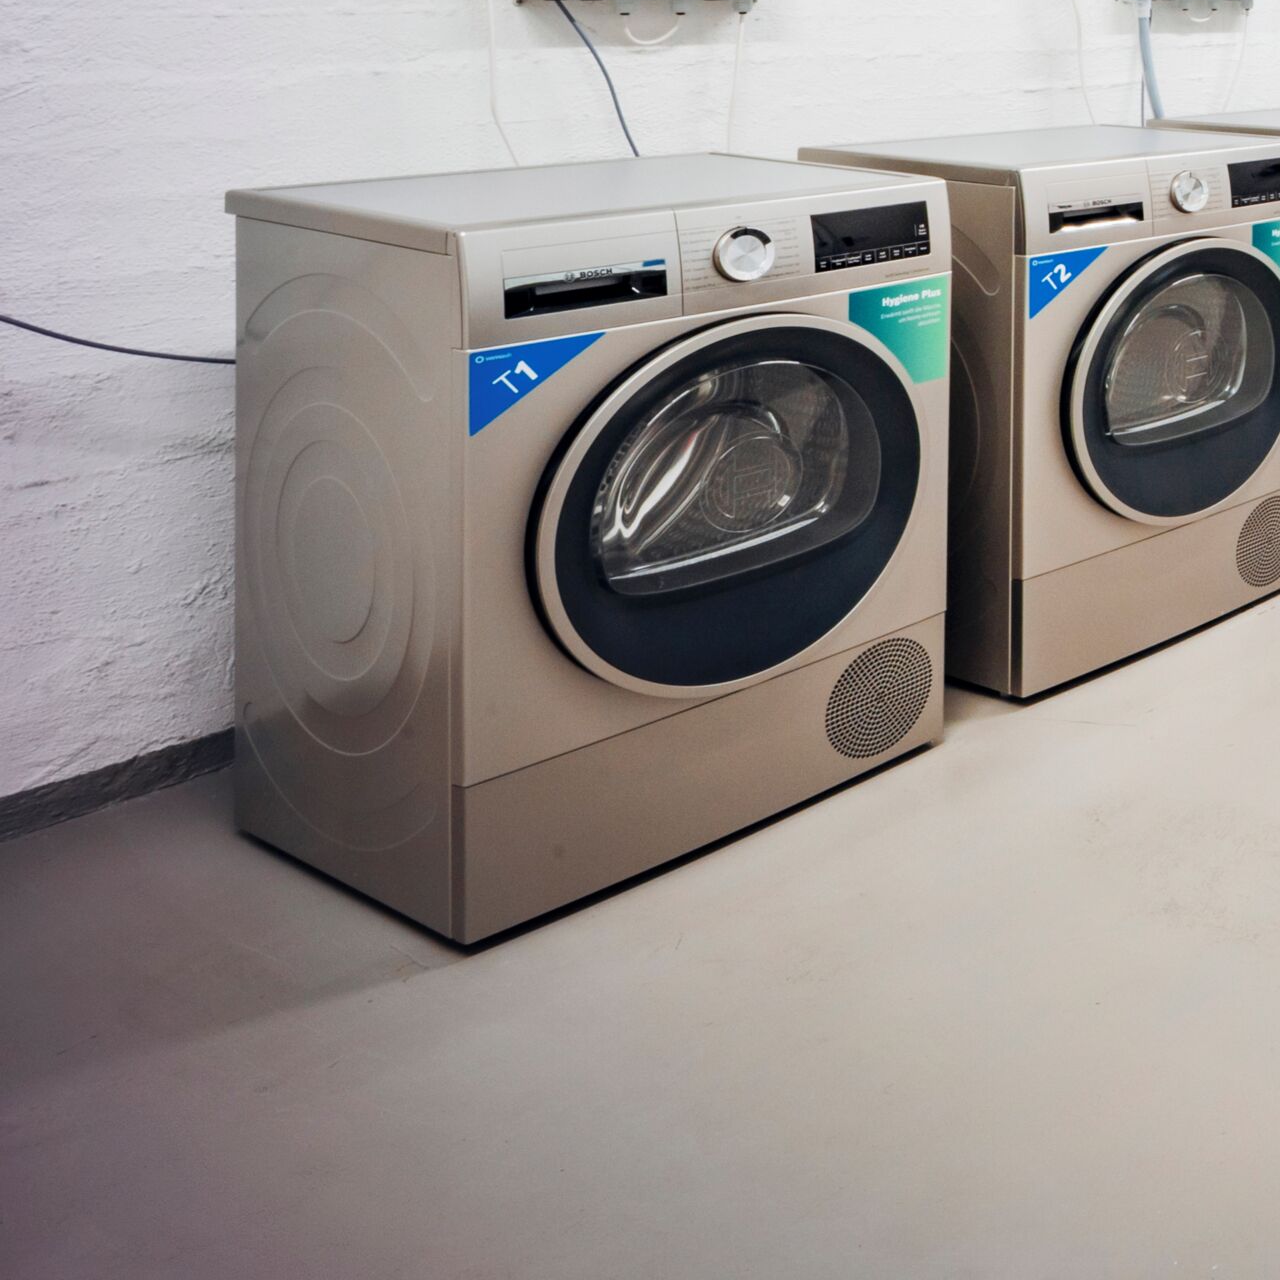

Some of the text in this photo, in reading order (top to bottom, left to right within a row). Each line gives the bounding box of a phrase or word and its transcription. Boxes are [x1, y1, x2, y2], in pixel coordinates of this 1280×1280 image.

[580, 267, 613, 280] BOSCH
[1041, 263, 1072, 290] T2
[881, 288, 942, 308] Hygiene Plus
[492, 360, 539, 394] T1
